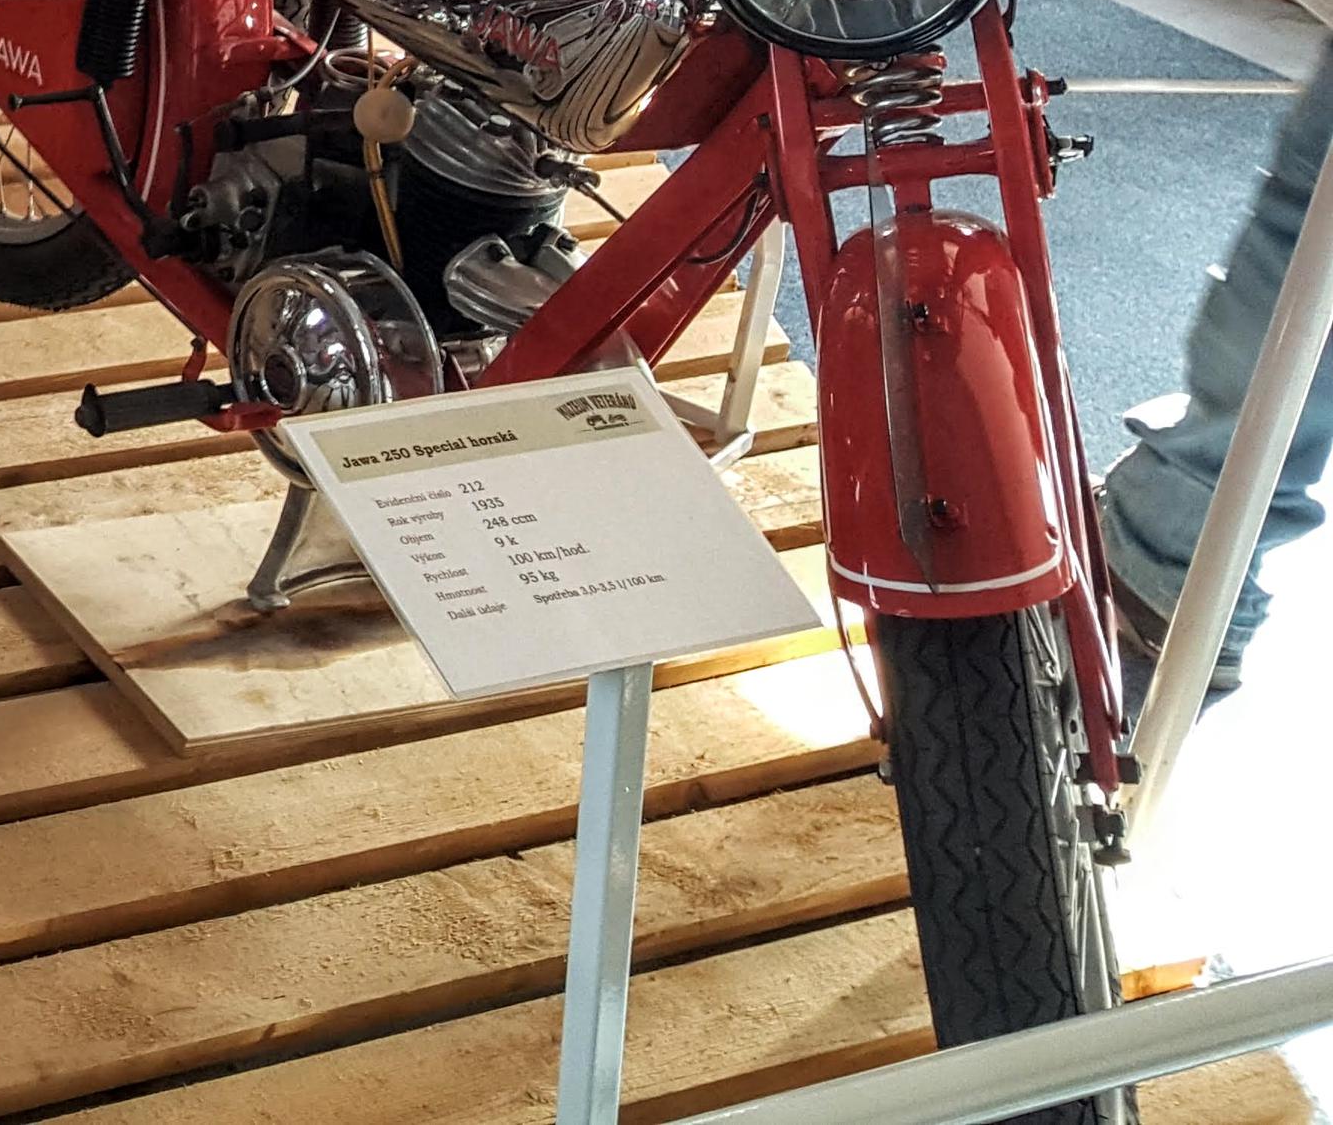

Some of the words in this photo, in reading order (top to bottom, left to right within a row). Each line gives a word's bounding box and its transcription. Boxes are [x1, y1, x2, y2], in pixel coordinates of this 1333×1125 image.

[342, 455, 381, 471] Jawa
[380, 447, 412, 464] 250
[412, 437, 469, 460] Special
[470, 428, 519, 452] horská
[458, 480, 486, 495] 212
[387, 515, 410, 528] Rok
[471, 497, 505, 513] 1935
[399, 531, 435, 547] Objem
[482, 515, 510, 531] 248
[511, 512, 538, 526] ccm
[410, 550, 446, 565] Výkon
[494, 536, 506, 548] 9
[507, 534, 520, 547] k
[423, 566, 470, 584] Rychlost
[507, 551, 536, 567] 100
[536, 542, 591, 562] km/hod.
[435, 584, 489, 603] Hmotnost
[519, 571, 540, 585] 95
[539, 569, 561, 584] kg
[532, 586, 581, 605] Spotřeba
